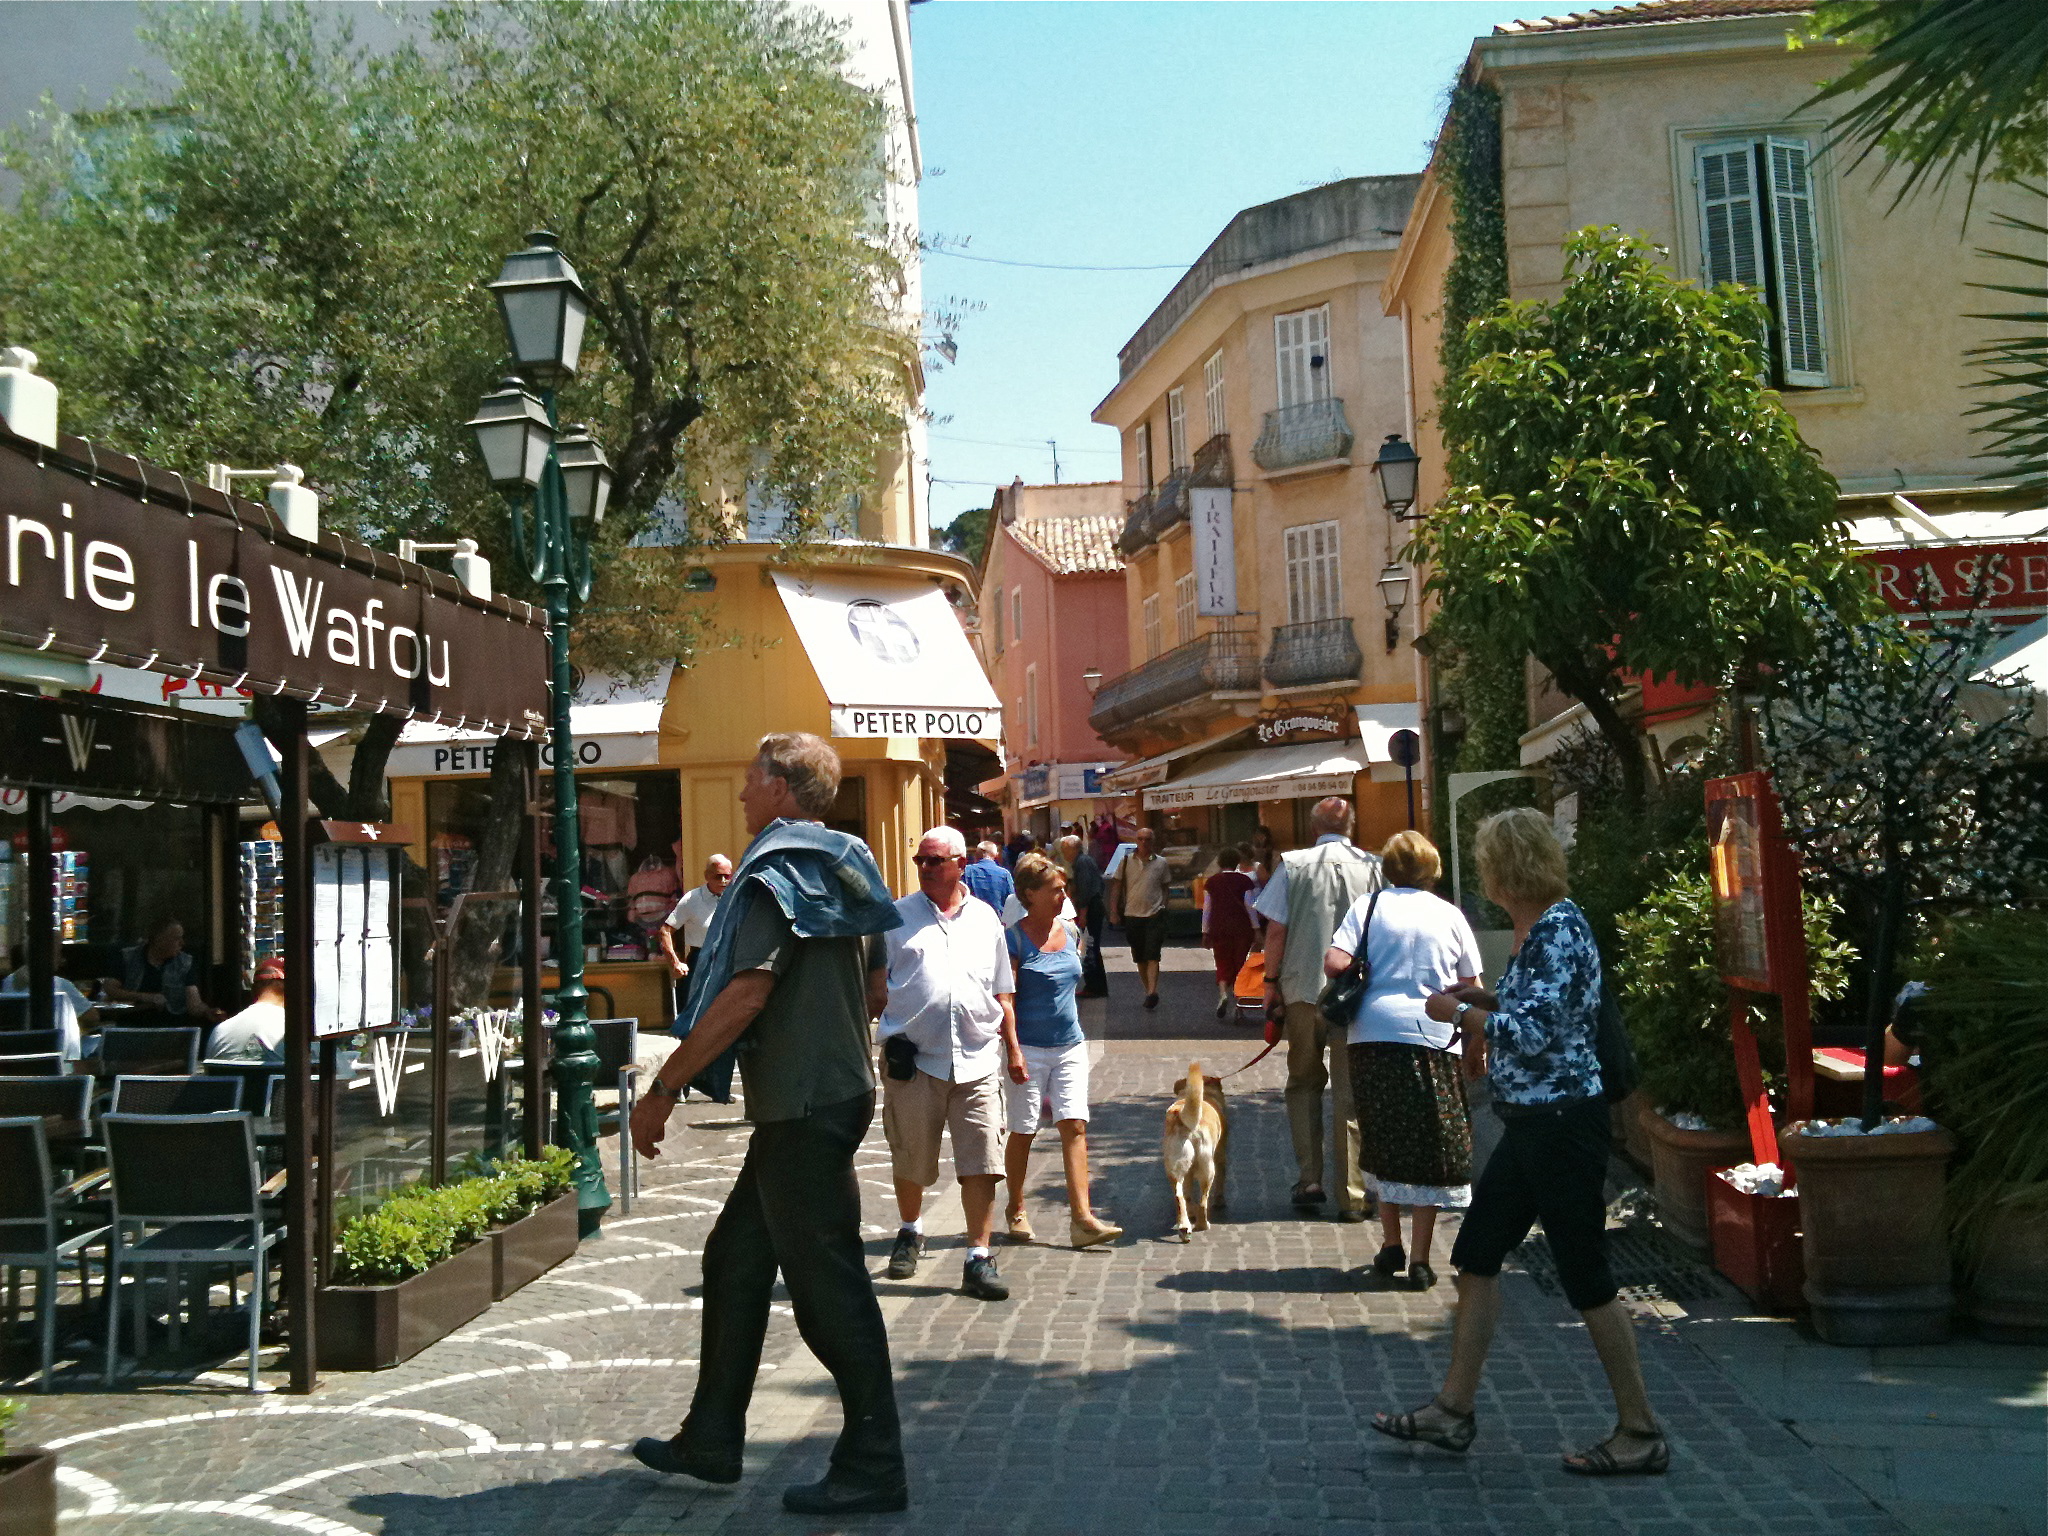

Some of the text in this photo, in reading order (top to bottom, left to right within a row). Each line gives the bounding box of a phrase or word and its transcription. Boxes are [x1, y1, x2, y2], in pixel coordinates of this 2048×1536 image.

[8, 503, 450, 688] rie le Wafou
[854, 712, 982, 735] PETER POLO
[1257, 715, 1339, 742] Le Grangousier
[435, 745, 495, 771] PETE
[1150, 791, 1194, 806] TRAITEUR
[1206, 787, 1219, 800] Le
[1220, 783, 1280, 804] Grangousier
